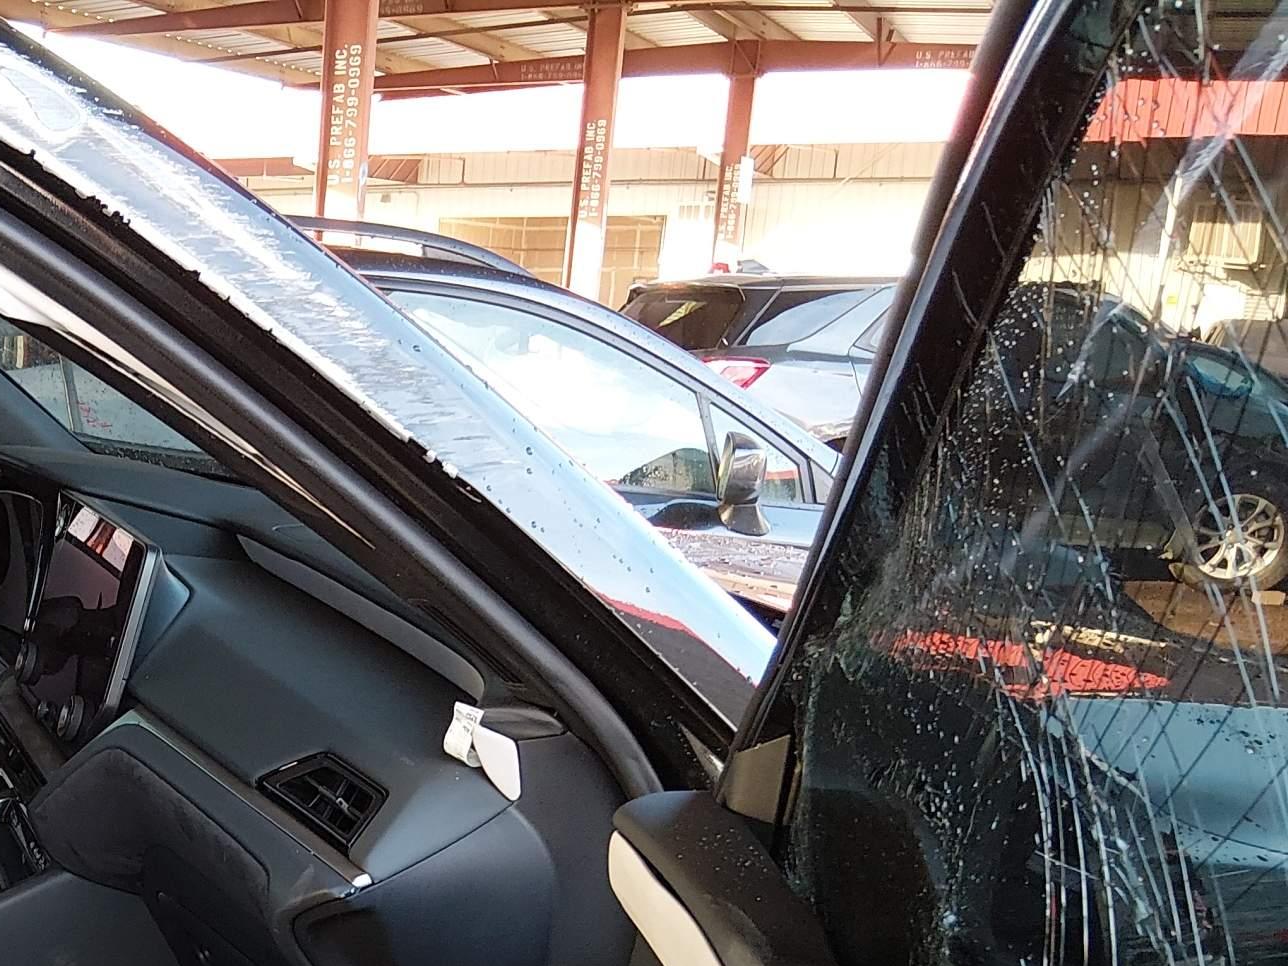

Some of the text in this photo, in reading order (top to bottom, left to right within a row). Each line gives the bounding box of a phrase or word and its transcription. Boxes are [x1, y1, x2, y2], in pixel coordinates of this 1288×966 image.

[334, 44, 349, 74] INC.
[330, 83, 346, 146] PREFAB
[580, 146, 594, 191] PREFAB
